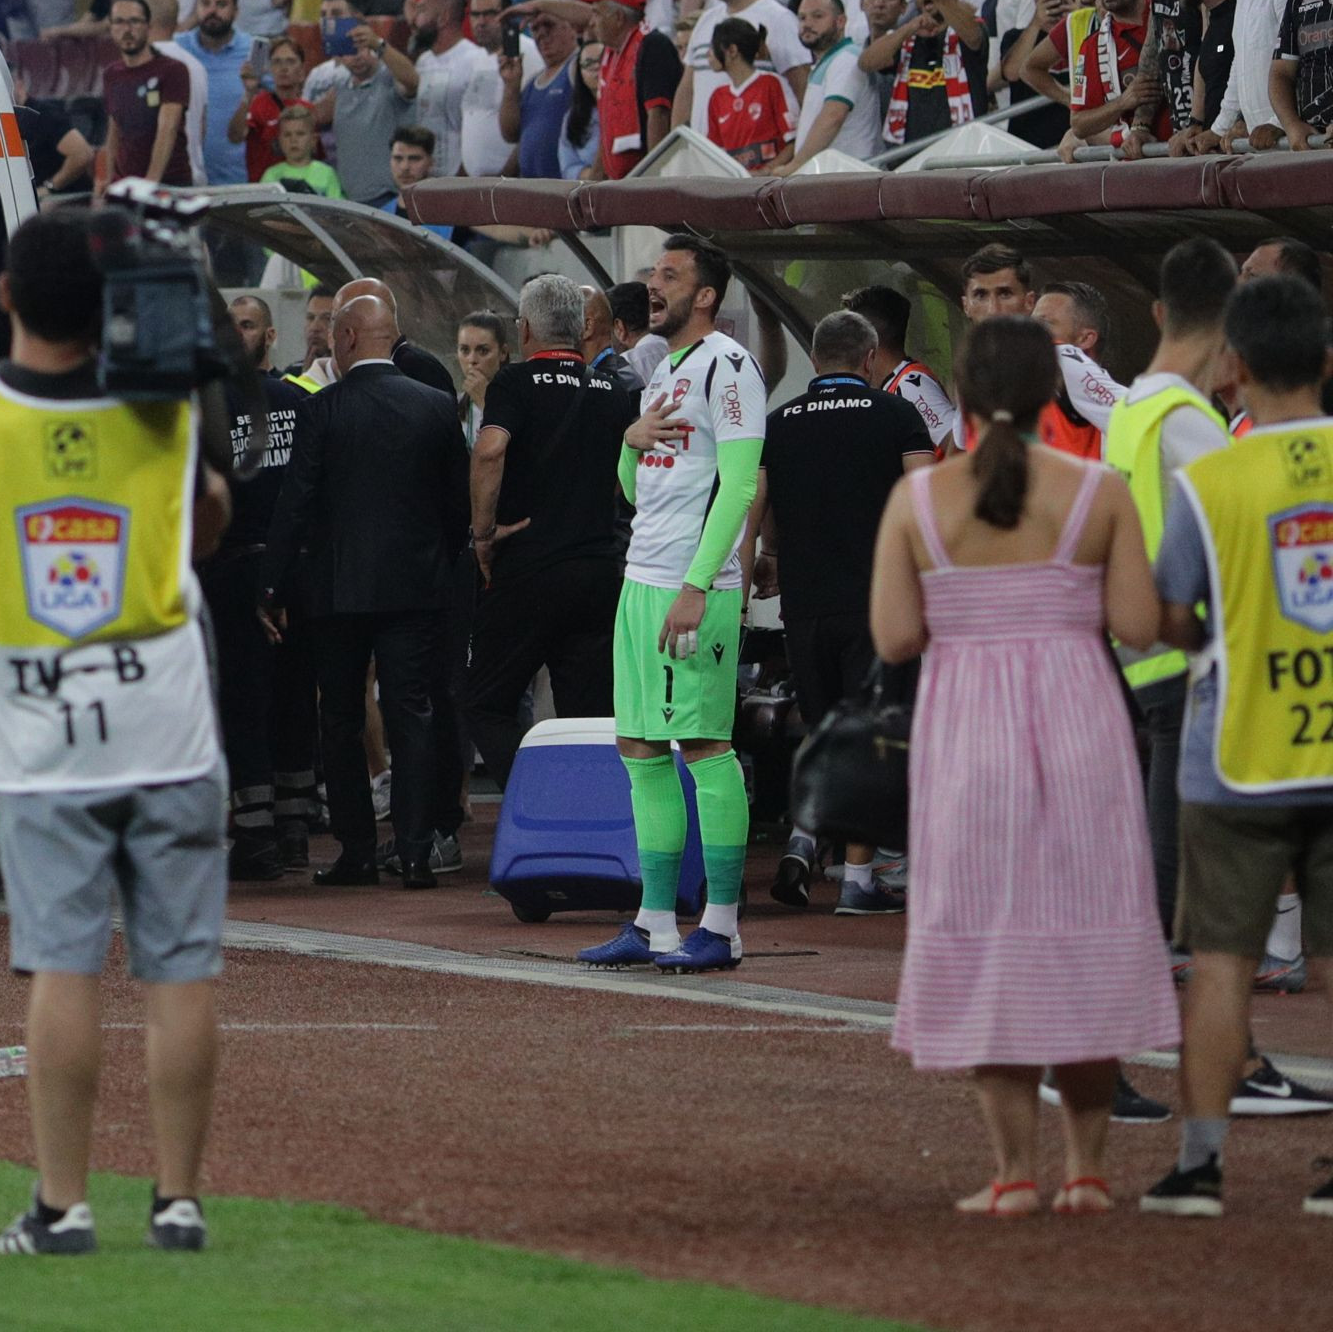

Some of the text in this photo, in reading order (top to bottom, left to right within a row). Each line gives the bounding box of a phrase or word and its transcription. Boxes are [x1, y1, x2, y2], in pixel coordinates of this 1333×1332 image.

[533, 374, 612, 391] FC DINMO
[724, 381, 744, 428] TORRY
[784, 399, 872, 417] FC DINAMO
[914, 395, 944, 428] TORRY
[663, 665, 673, 704] 1
[59, 701, 108, 746] 11
